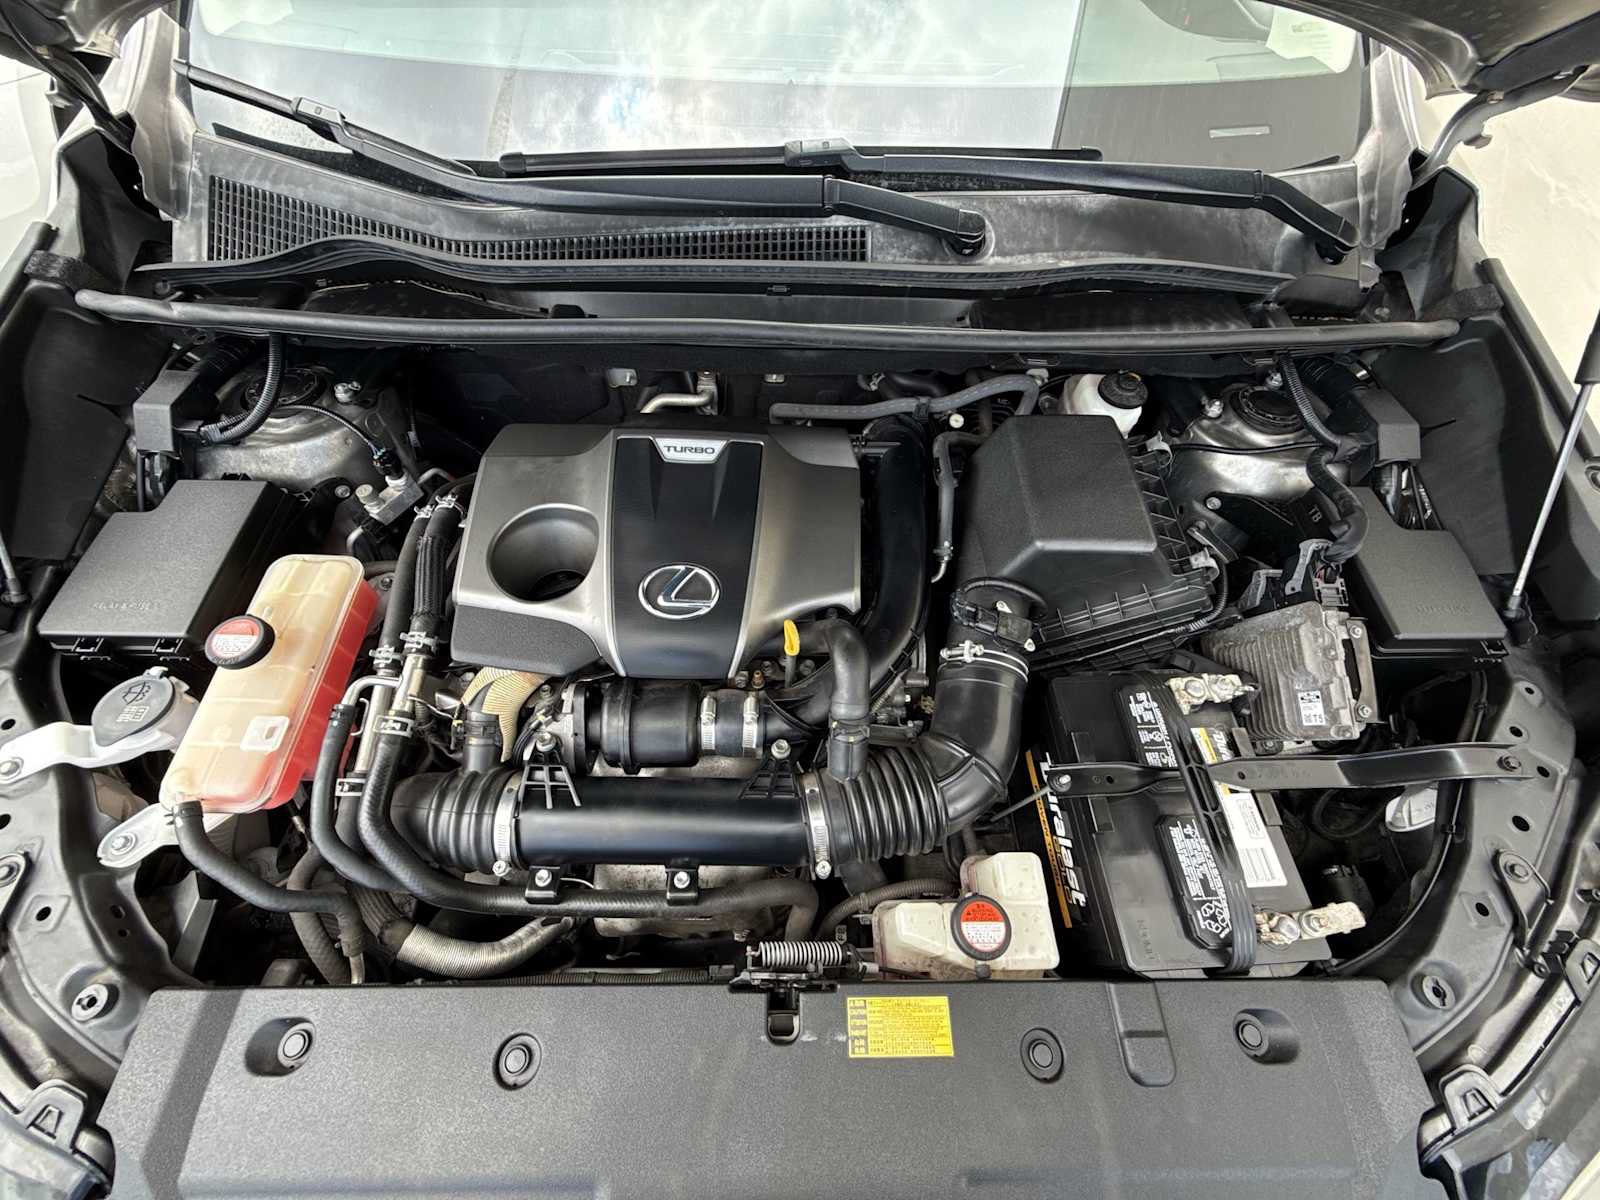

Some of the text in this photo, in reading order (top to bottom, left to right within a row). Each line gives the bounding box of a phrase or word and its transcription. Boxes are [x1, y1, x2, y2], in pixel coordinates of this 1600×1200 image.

[664, 445, 715, 455] TURBO
[1308, 504, 1322, 523] TB
[1034, 783, 1049, 837] POVEN
[1053, 835, 1073, 905] GOLD
